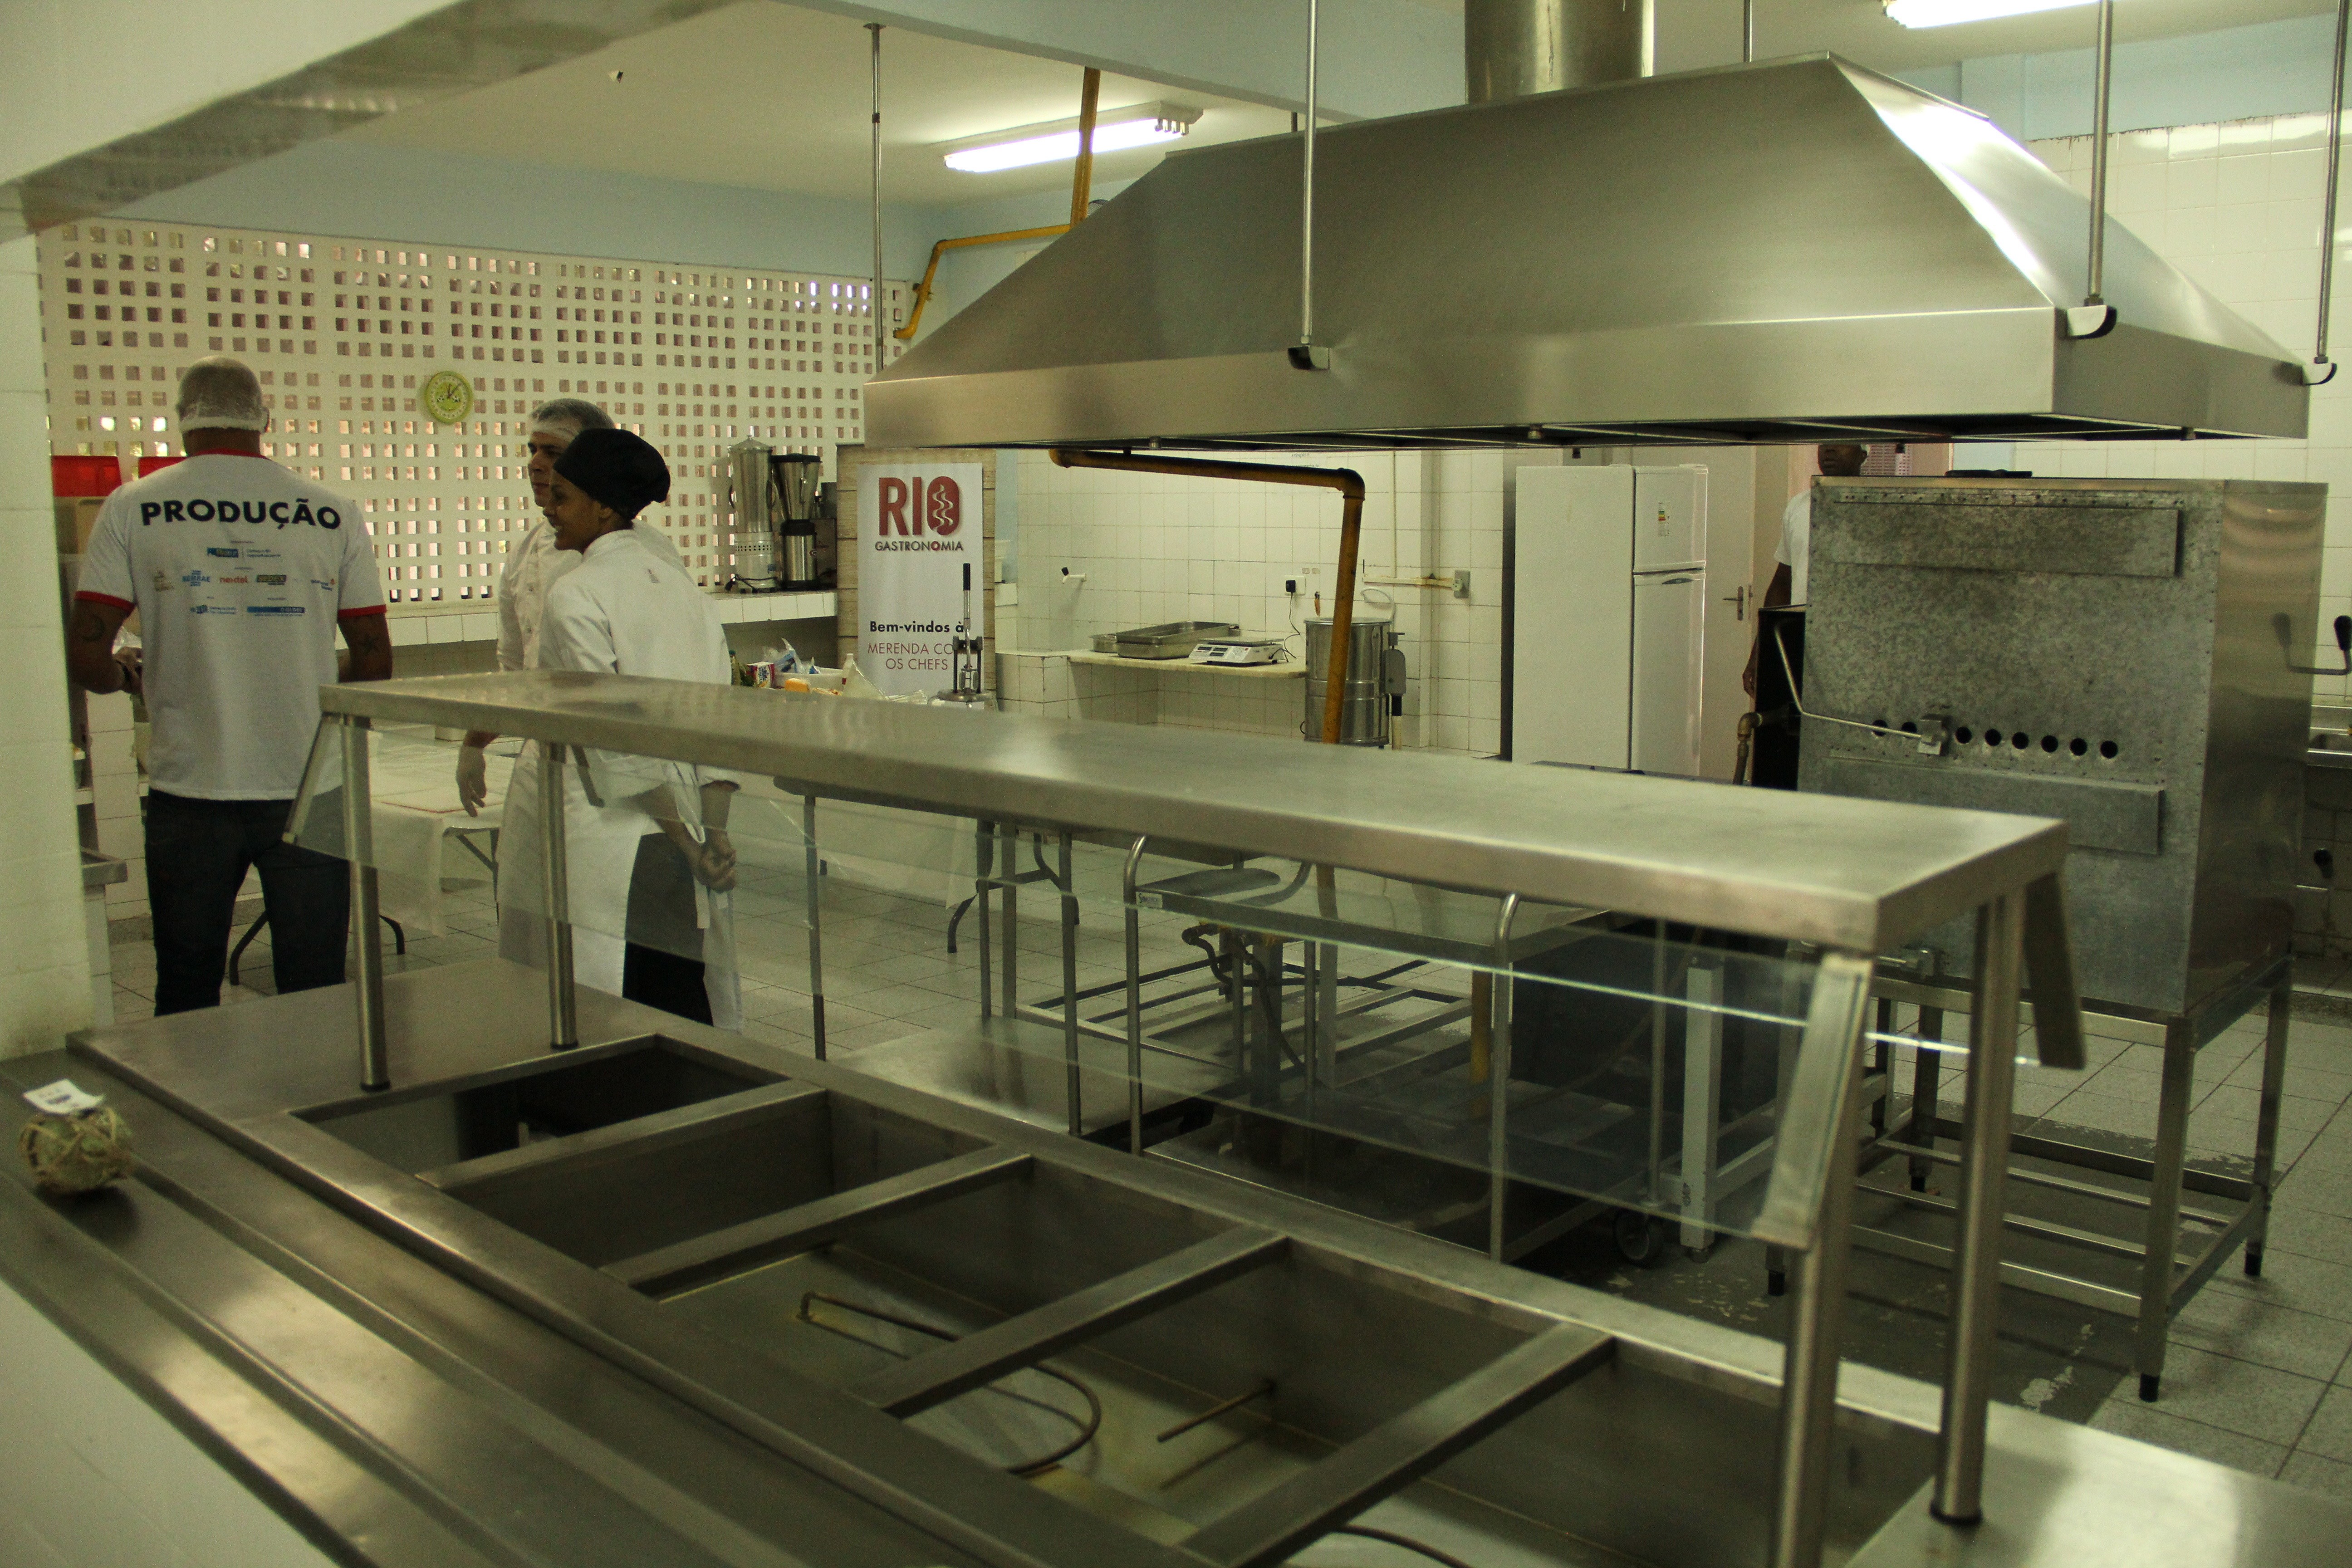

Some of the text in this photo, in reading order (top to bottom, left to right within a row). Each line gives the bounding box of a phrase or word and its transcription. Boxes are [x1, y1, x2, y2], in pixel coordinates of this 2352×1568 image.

[879, 476, 959, 535] RIO
[141, 498, 341, 529] PRODUÇÃO
[875, 541, 963, 551] GASTRONOMIA
[870, 621, 964, 632] Bem-vindos à
[868, 643, 953, 655] MERENDA CO
[886, 658, 948, 670] OS CHEFS
